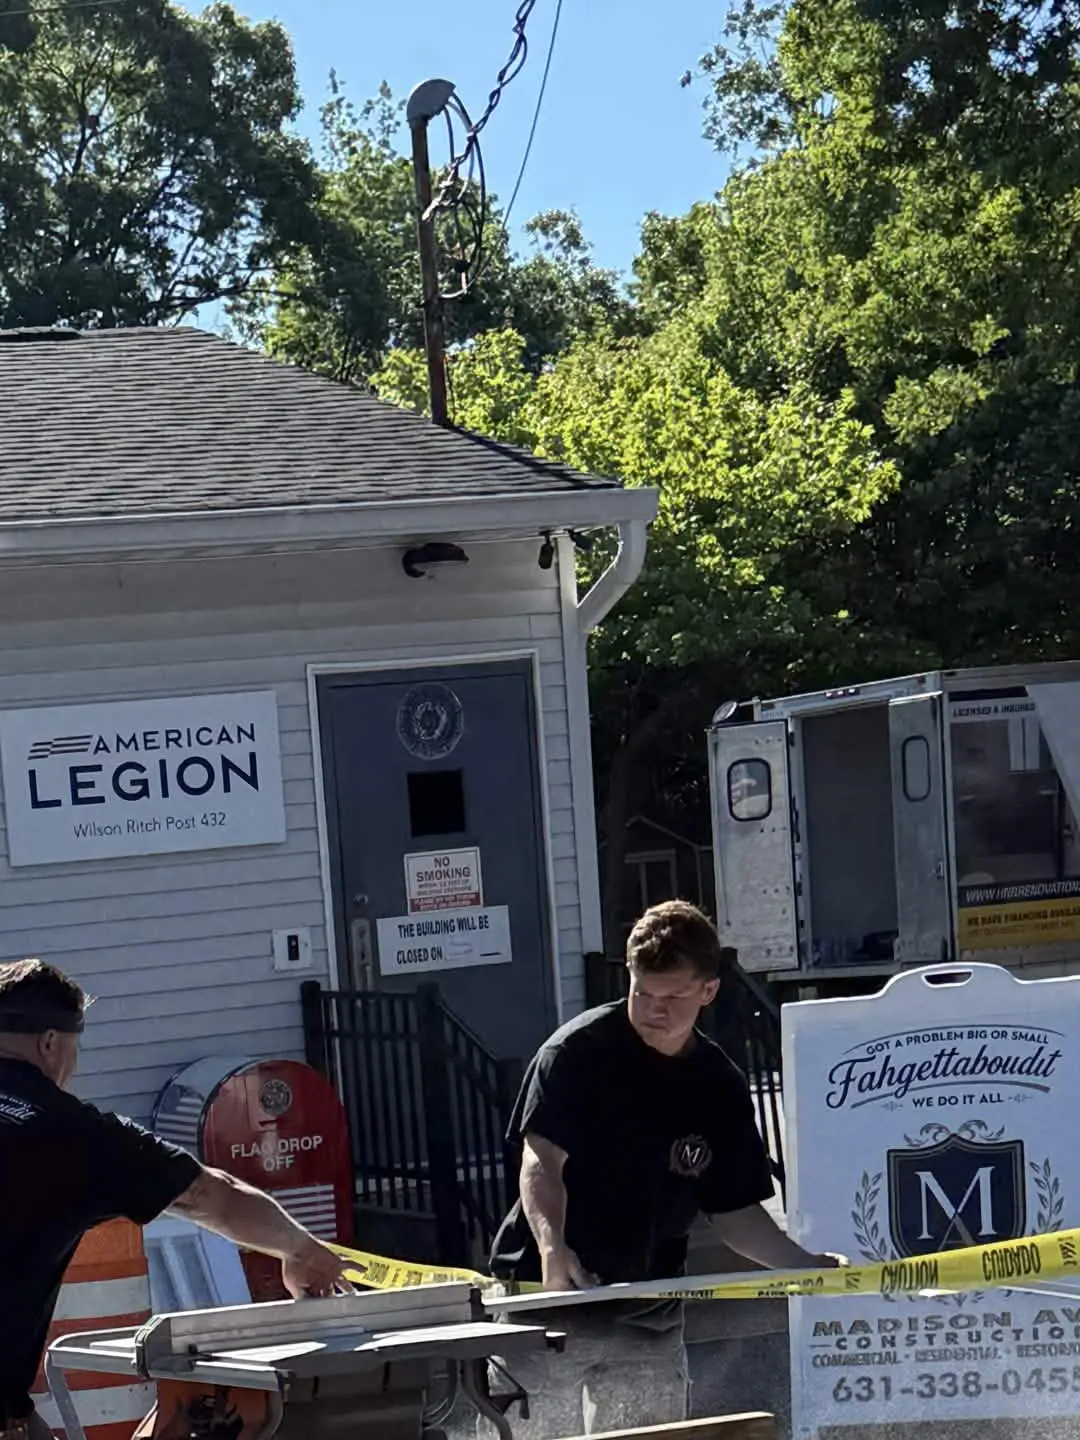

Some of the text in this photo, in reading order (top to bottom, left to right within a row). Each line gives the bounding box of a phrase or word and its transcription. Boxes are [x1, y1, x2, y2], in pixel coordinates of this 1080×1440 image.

[93, 723, 256, 755] AMERICAN
[28, 752, 259, 809] LEGION
[73, 812, 226, 838] Wilson Ritch Post 432
[434, 856, 450, 868] NO
[416, 866, 470, 882] SMOKING
[398, 915, 489, 938] THE BUILDING WILL BE
[397, 946, 443, 964] CLOSED ON
[866, 1030, 1049, 1055] GOT A PROBLEM BIG OR SMALL
[826, 1044, 1063, 1109] Fahgettaboudit
[912, 1093, 1004, 1108] WE DO IT ALL
[231, 1136, 323, 1159] FLAG DROP
[262, 1156, 295, 1172] OFF
[813, 1311, 1012, 1337] MADISON
[812, 1351, 902, 1368] COMMERCIAL
